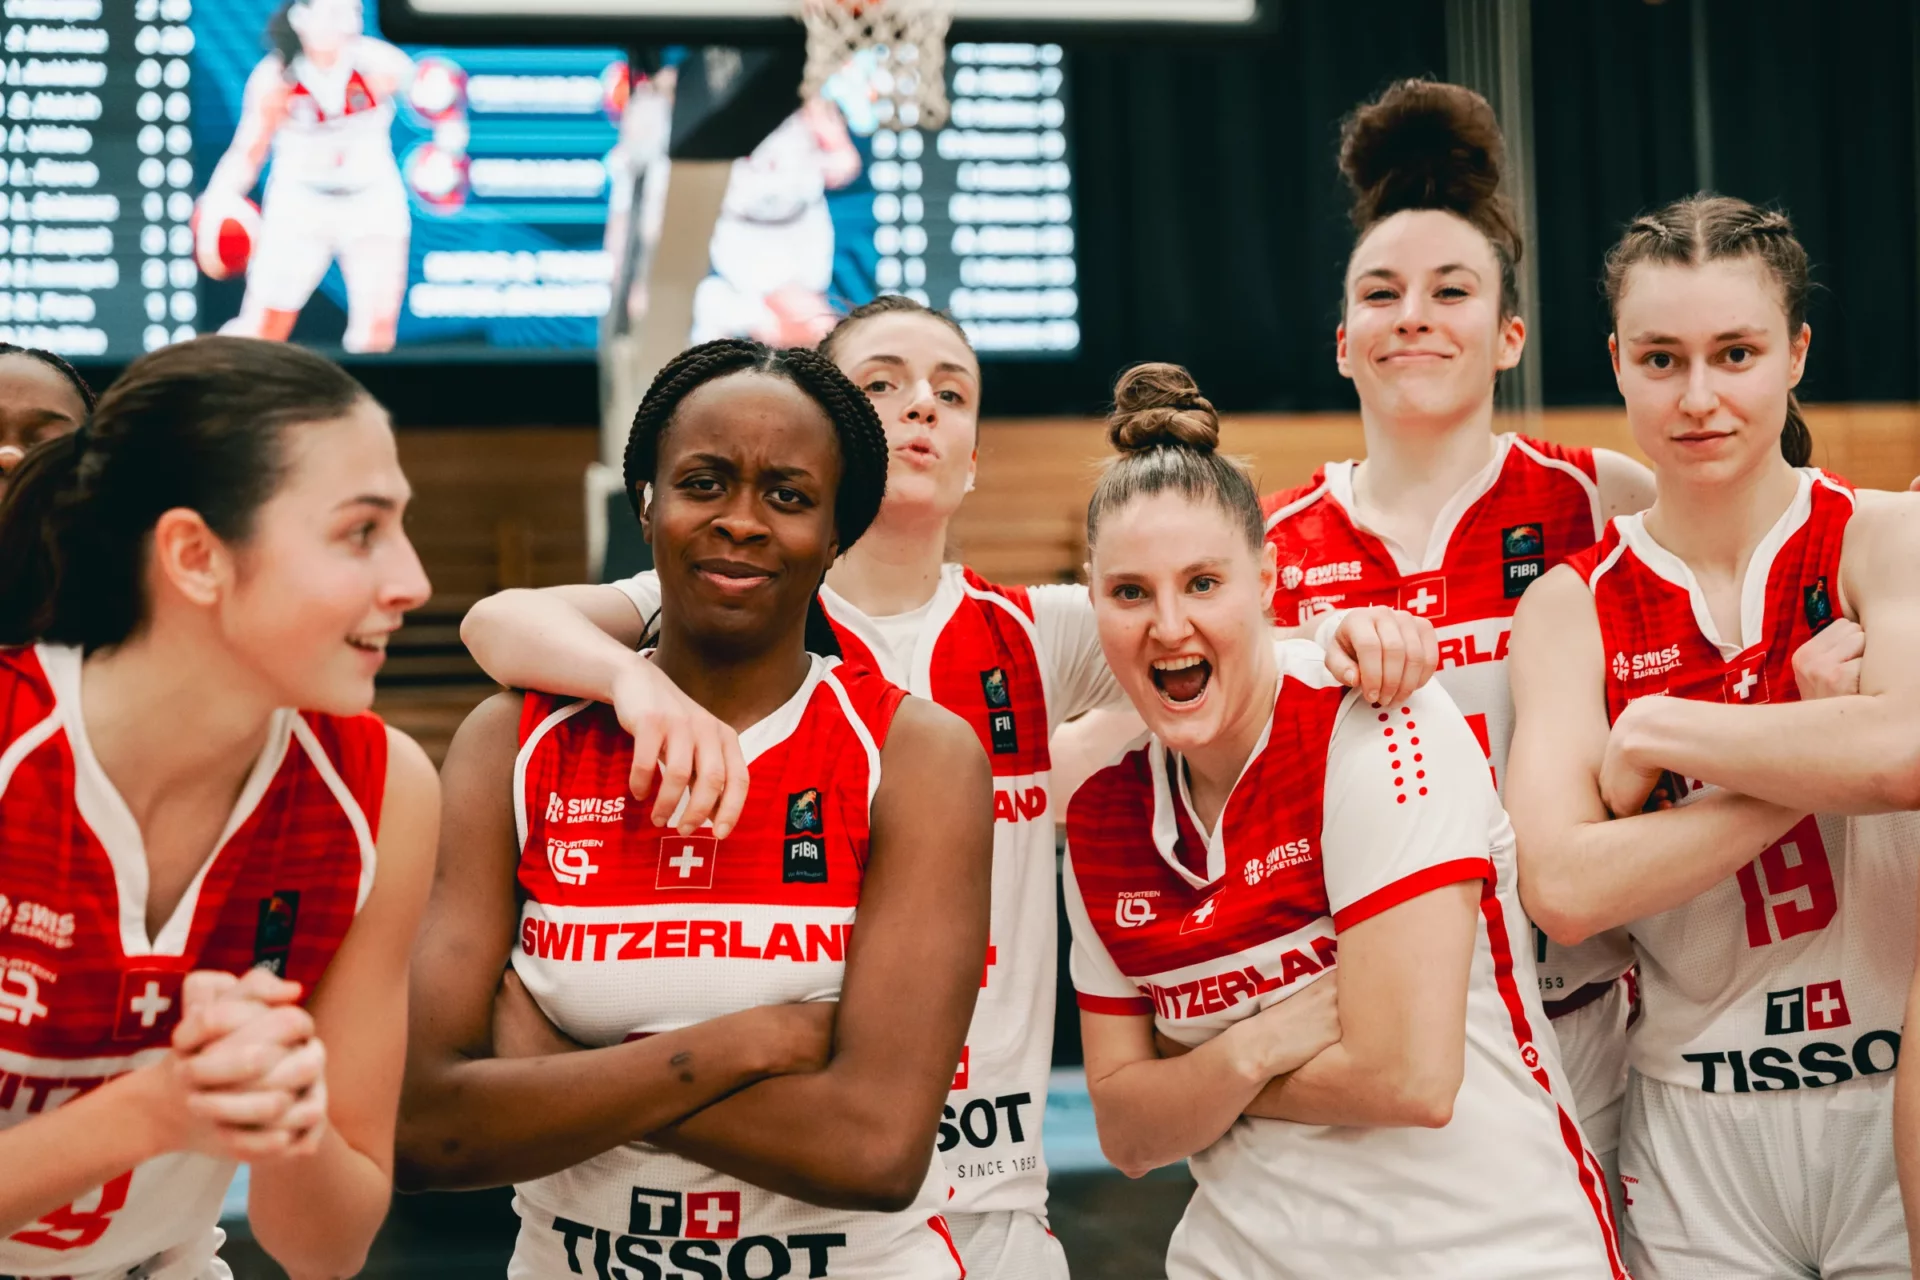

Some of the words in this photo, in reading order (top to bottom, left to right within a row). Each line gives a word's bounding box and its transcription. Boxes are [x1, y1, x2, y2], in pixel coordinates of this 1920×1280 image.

[1305, 560, 1362, 580] SWISS
[1510, 563, 1538, 579] FIBA
[1632, 644, 1680, 670] SWISS
[1633, 659, 1683, 679] BASKETBALL
[567, 796, 625, 815] SWISS
[567, 812, 623, 824] BASKETBALL
[547, 837, 604, 849] FOURTEEN
[791, 841, 818, 860] FIBA
[1266, 838, 1311, 869] SWISS
[1266, 853, 1313, 878] BSKETBALL
[1736, 813, 1838, 948] 19
[1118, 889, 1160, 898] FOURTEEN
[1681, 1029, 1903, 1093] TISSO
[937, 1091, 1031, 1153] SOT
[957, 1160, 1005, 1178] SINCE
[1012, 1155, 1036, 1172] 1853
[552, 1216, 847, 1280] TISSOT
